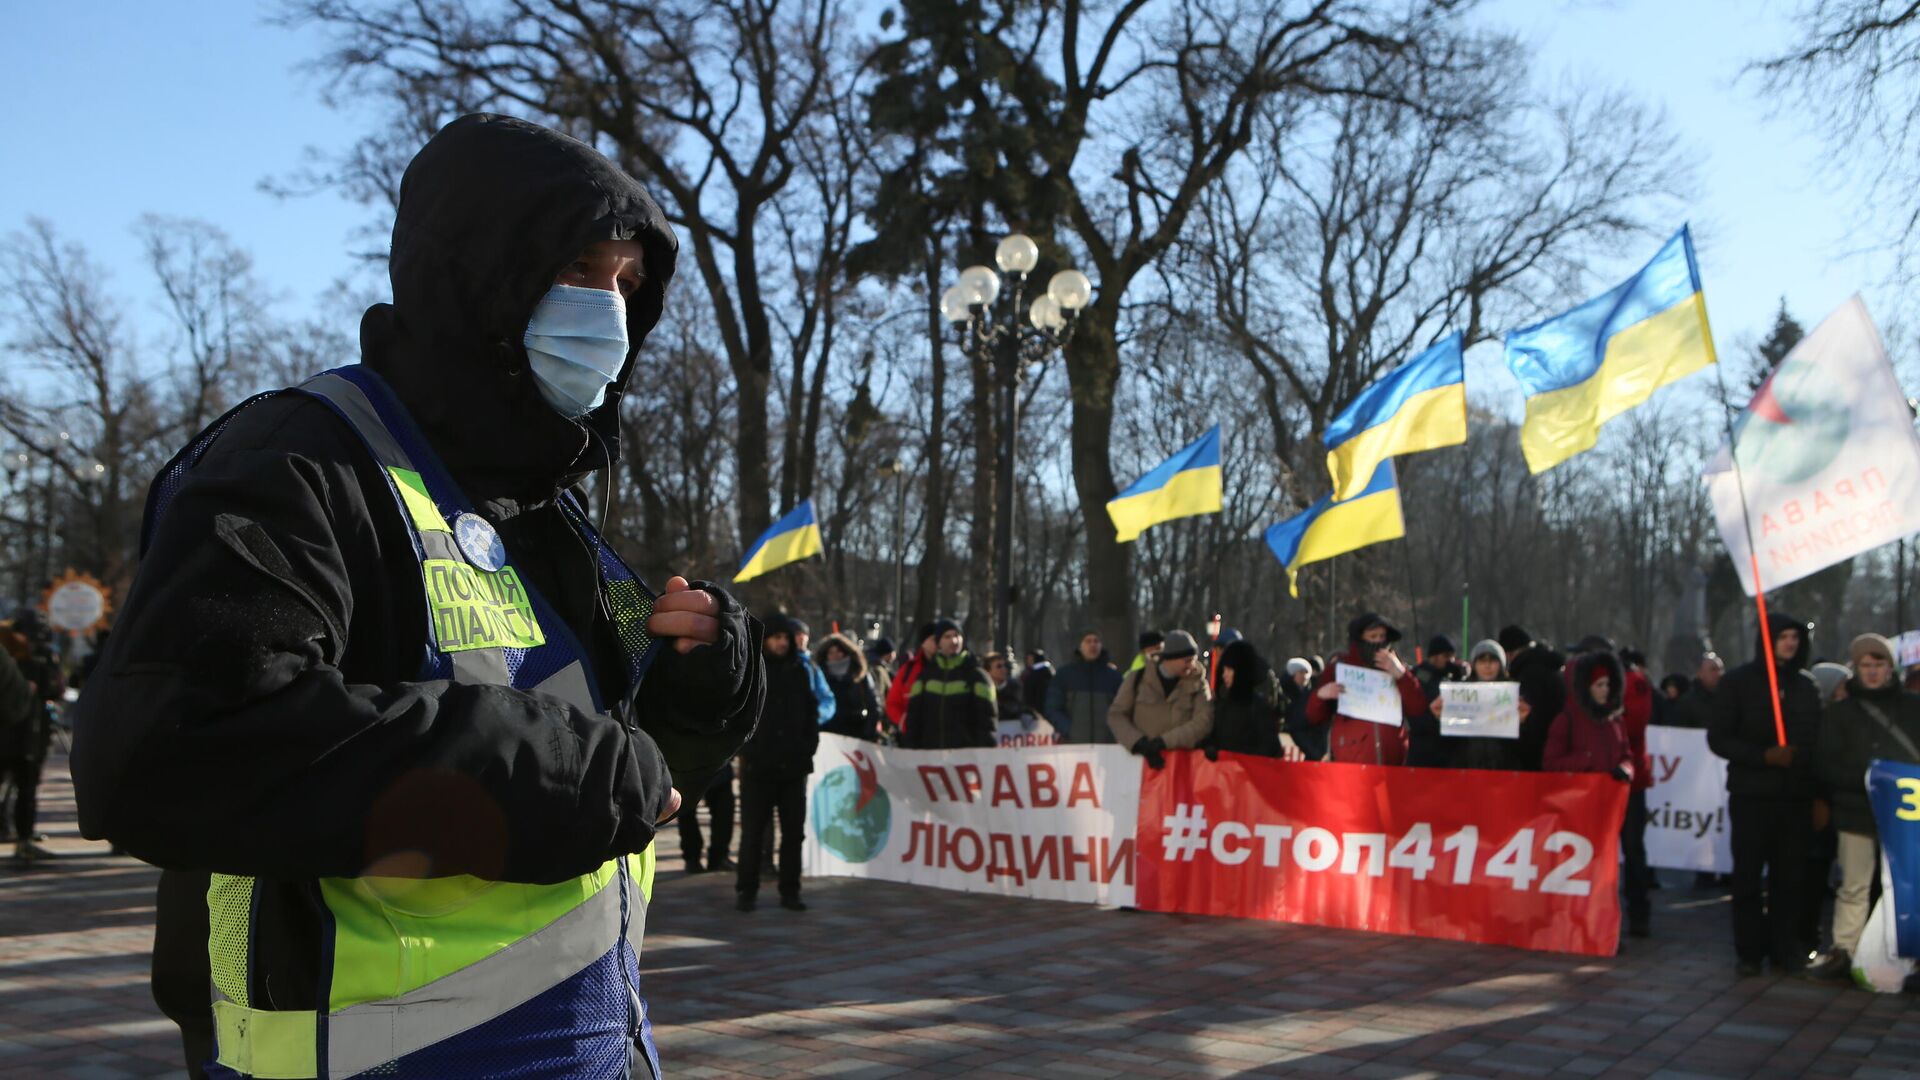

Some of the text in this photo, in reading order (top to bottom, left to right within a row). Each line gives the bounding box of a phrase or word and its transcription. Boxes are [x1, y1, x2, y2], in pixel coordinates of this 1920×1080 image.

[431, 565, 523, 607] ПОЛЦІЯ
[917, 761, 1101, 809] ПРАВА
[901, 821, 1135, 886] ЛЮДИНИ
[1162, 803, 1594, 896] #стоп4142
